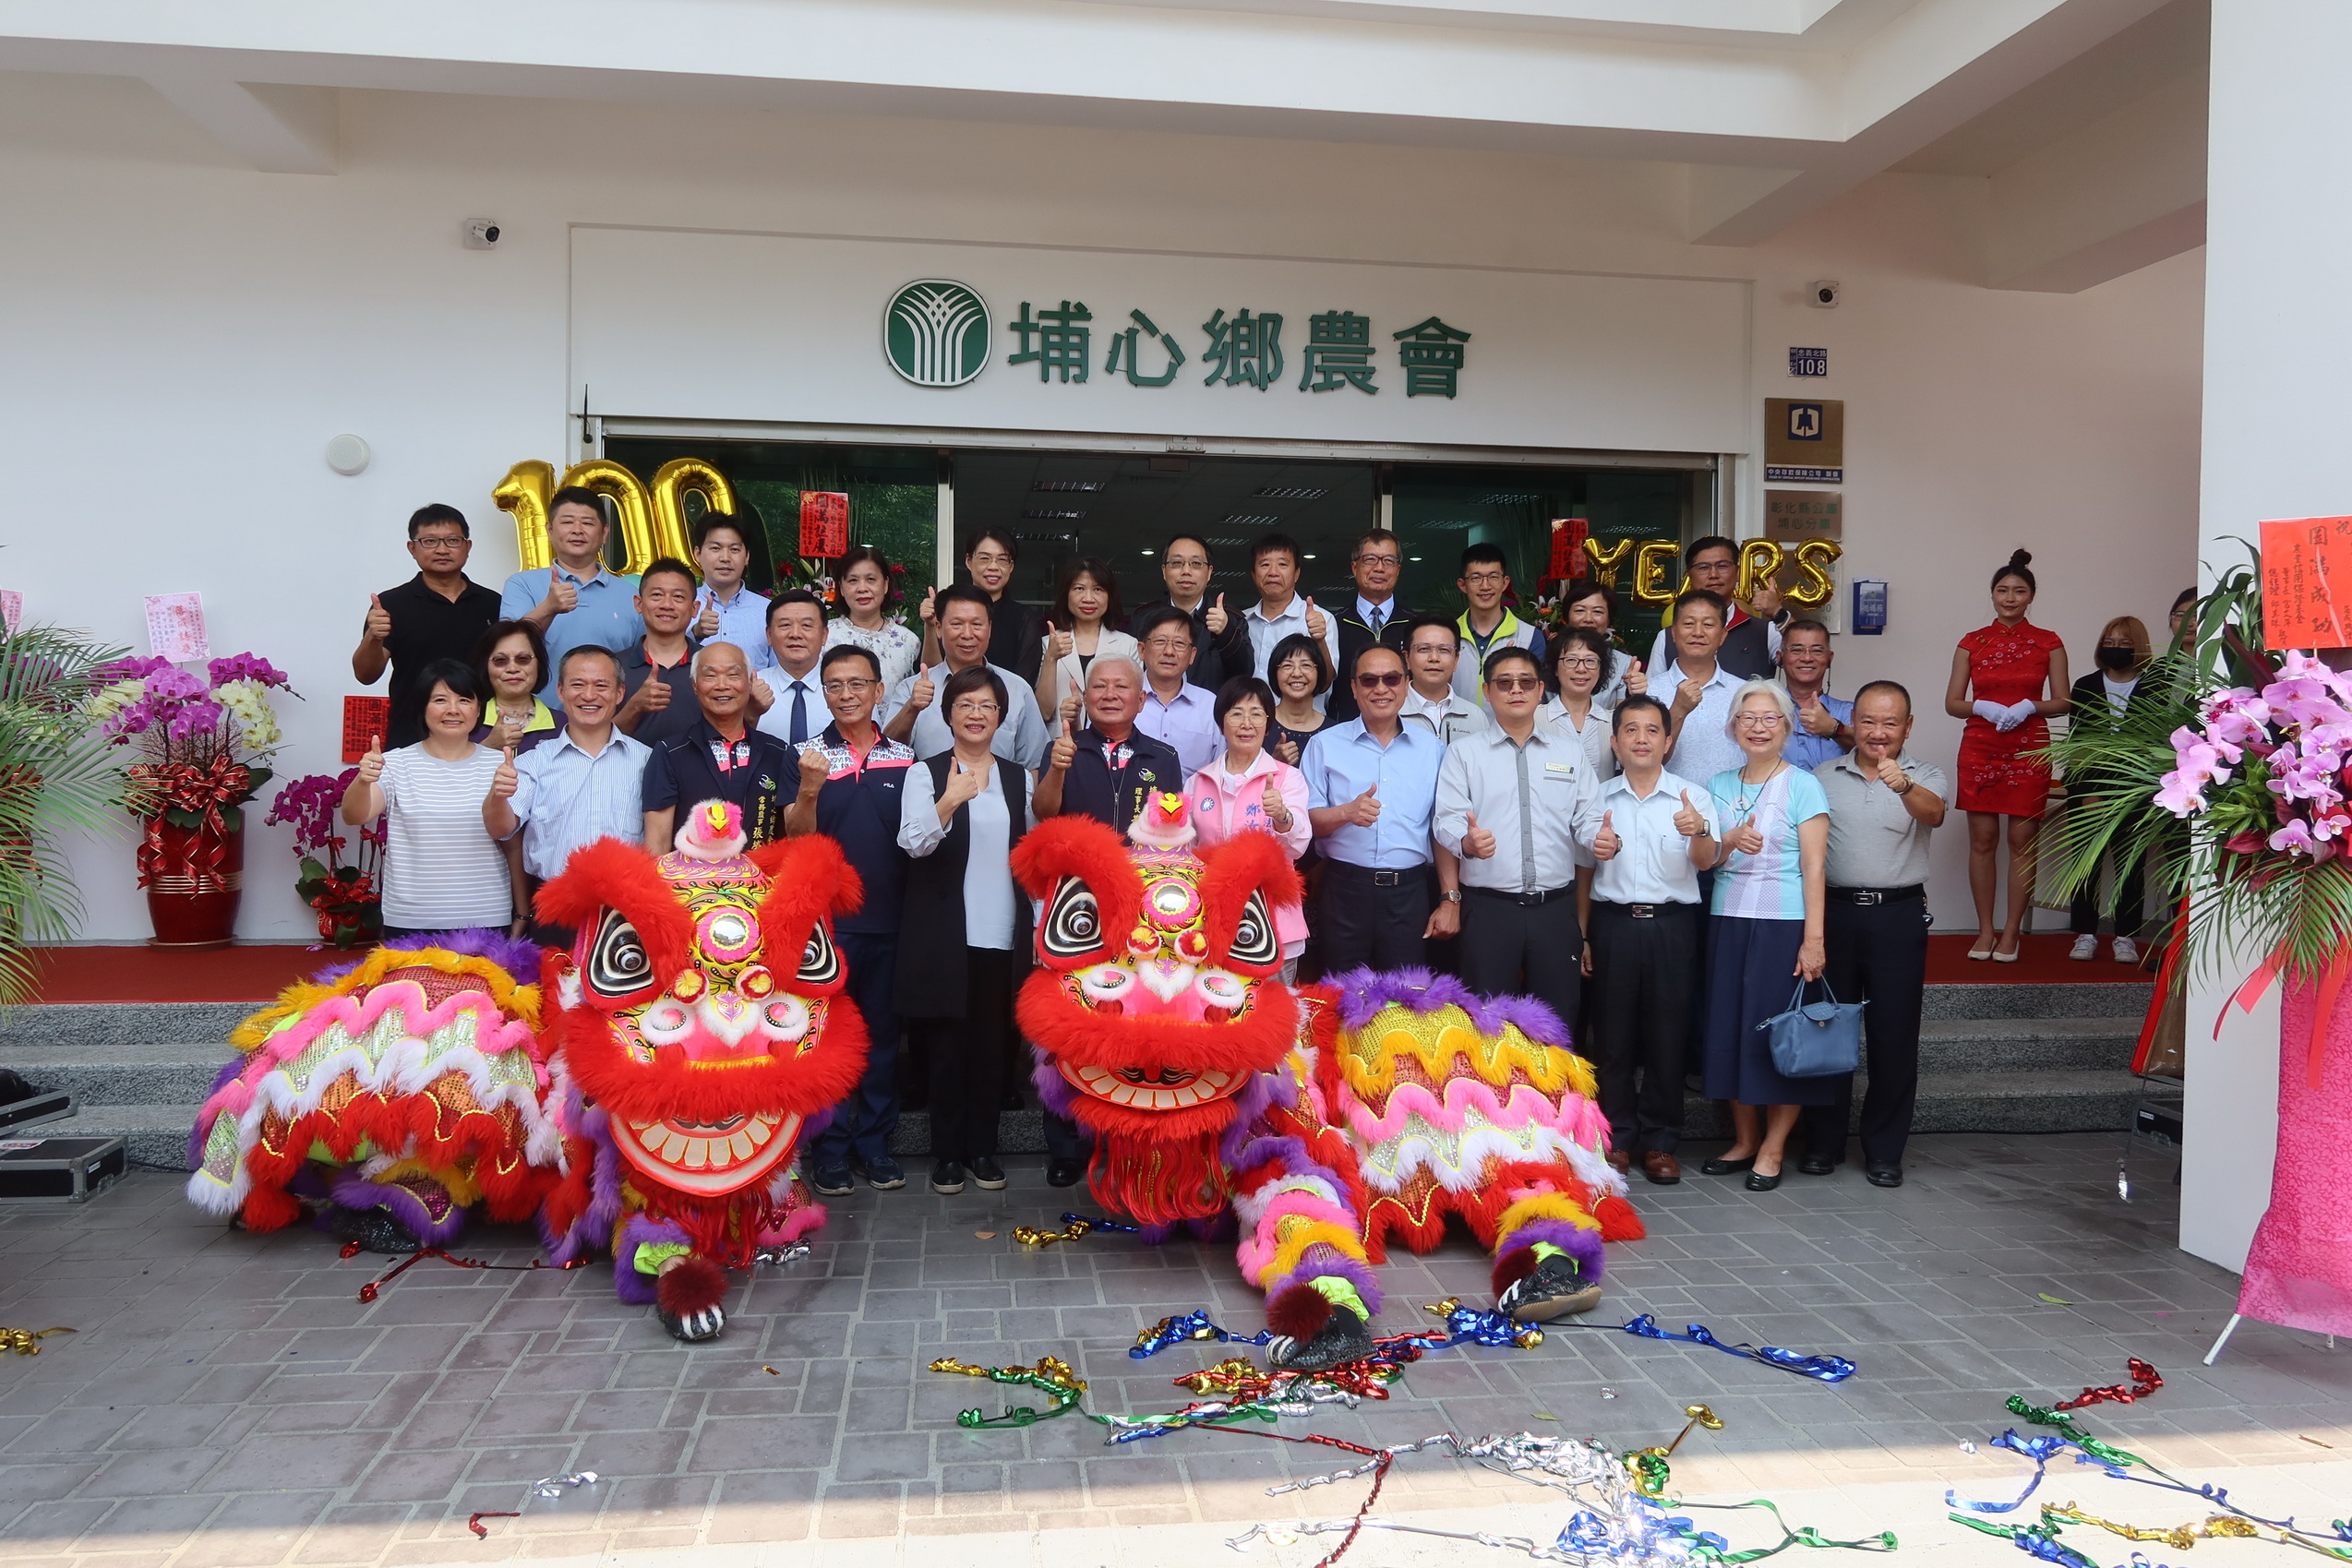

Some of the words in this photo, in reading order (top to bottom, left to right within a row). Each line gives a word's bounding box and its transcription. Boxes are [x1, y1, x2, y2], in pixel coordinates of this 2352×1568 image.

[1008, 300, 1471, 400] 埔心鄉農會
[1798, 359, 1826, 375] 108
[1768, 468, 1821, 477] 中央存款保險公司
[490, 458, 738, 577] 100
[1771, 501, 1838, 514] 彰化縣公庫
[1778, 518, 1830, 530] 埔心分庫
[1581, 537, 1842, 610] YERS
[1134, 787, 1143, 813] 理事長
